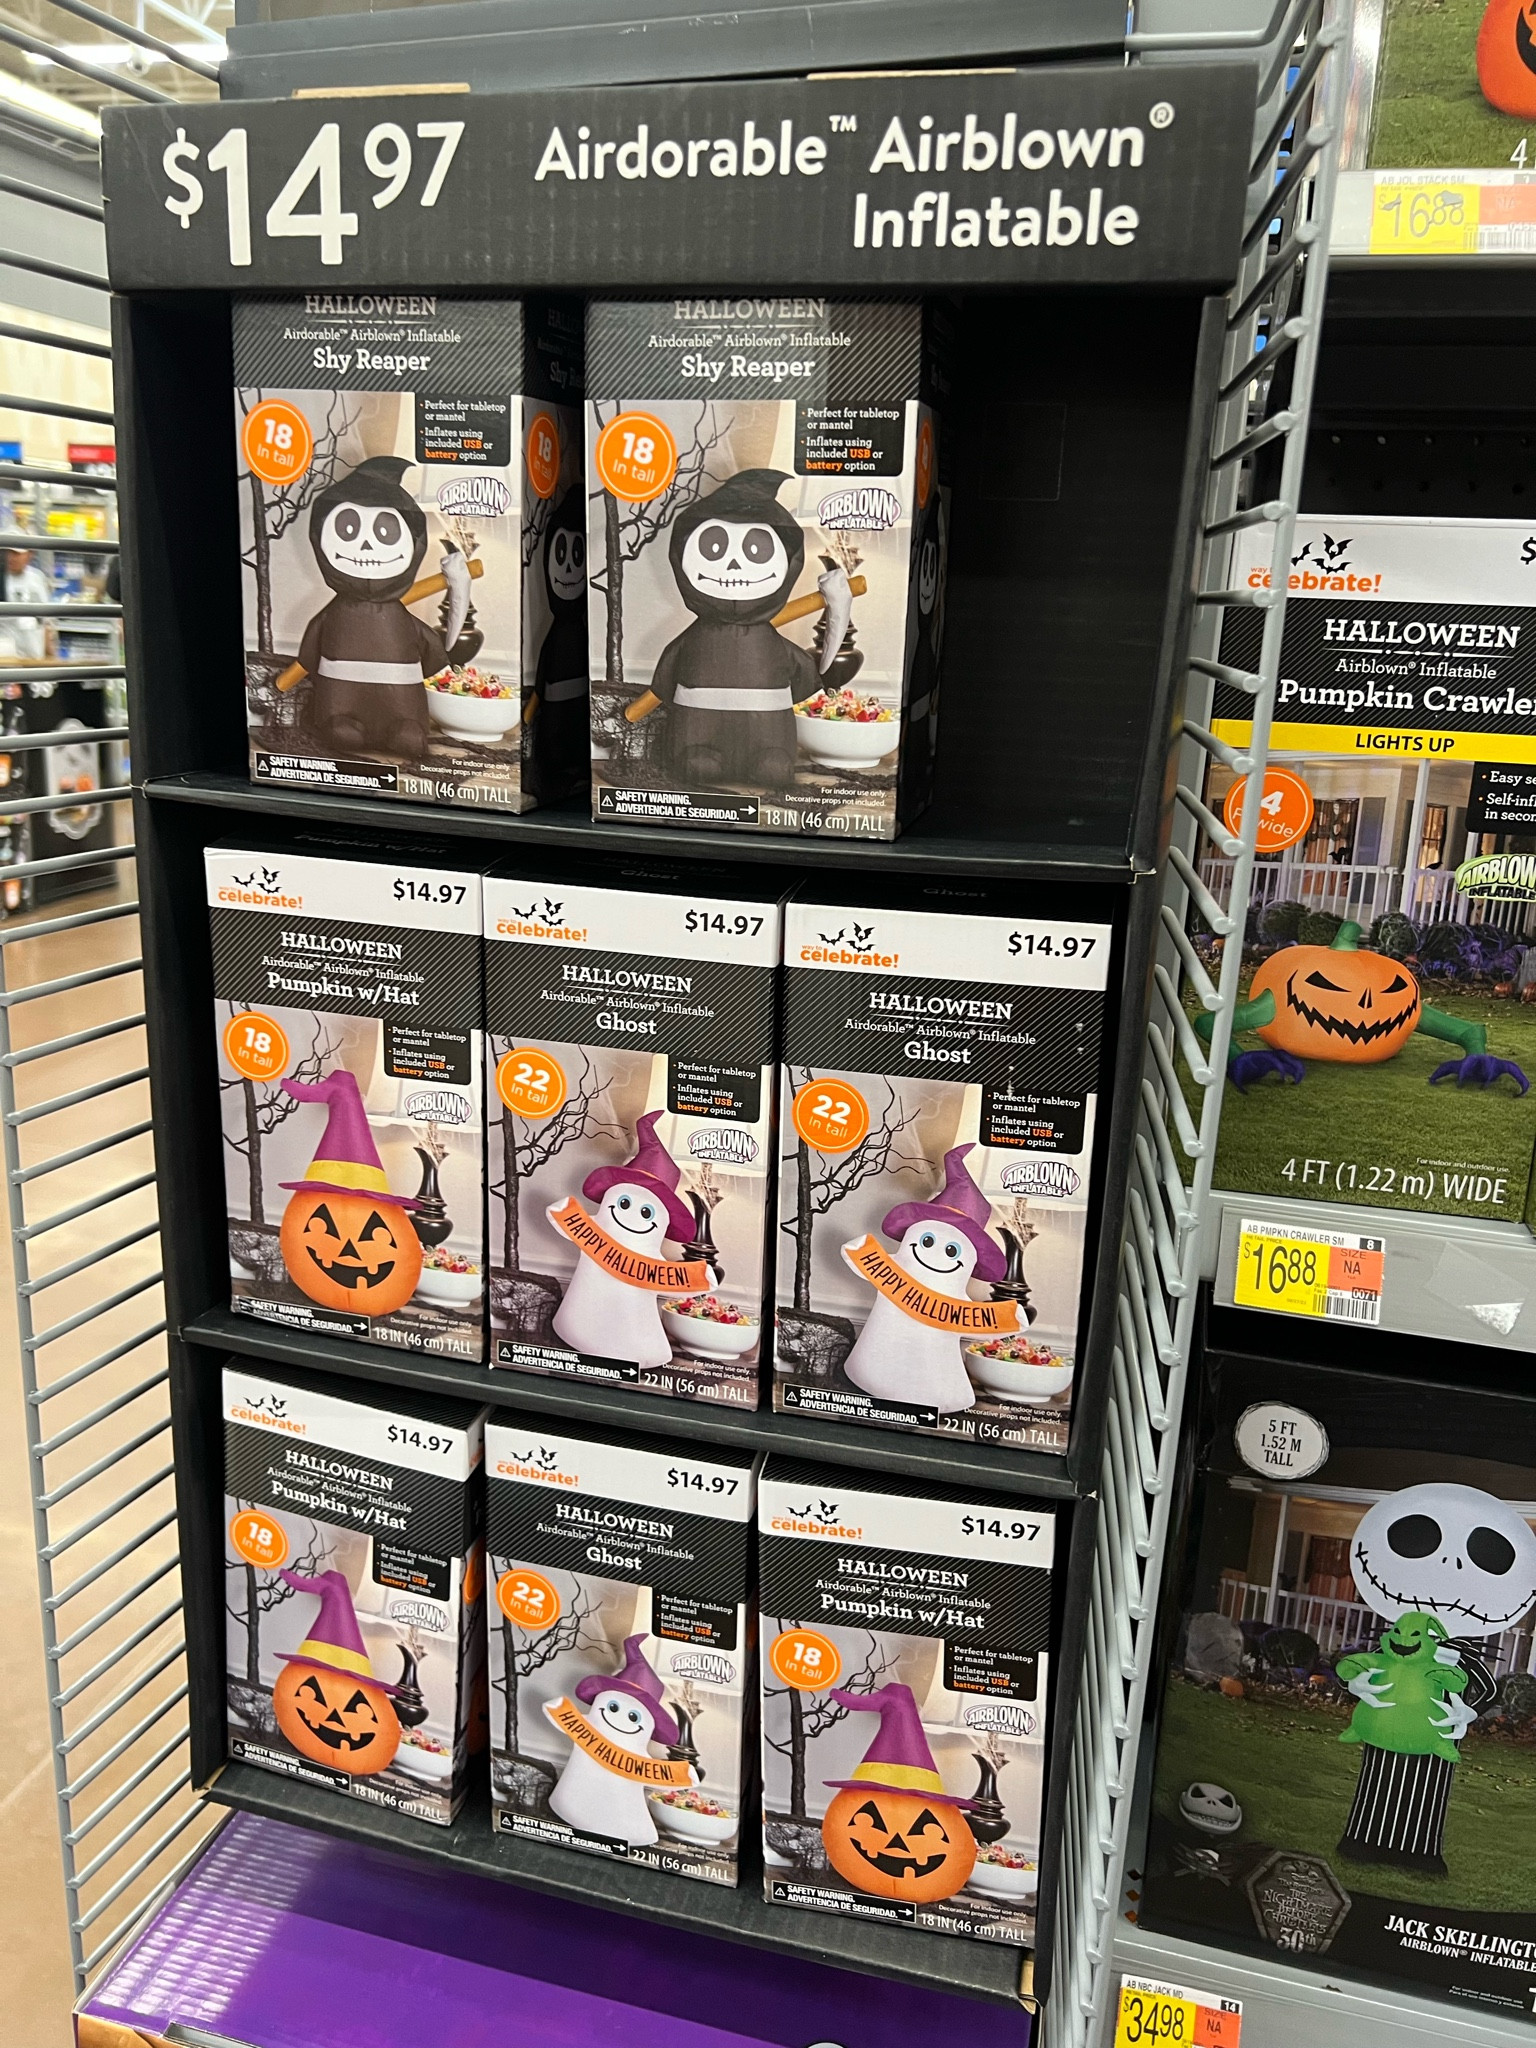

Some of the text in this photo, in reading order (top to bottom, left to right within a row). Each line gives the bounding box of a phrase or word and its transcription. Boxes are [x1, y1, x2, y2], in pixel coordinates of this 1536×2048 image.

[1418, 176, 1448, 184] STACK
[852, 191, 1140, 249] Inflatable
[305, 296, 437, 316] HALLOWEEN
[674, 298, 825, 319] HALLOWEEN
[790, 333, 851, 347] Inflatable
[313, 347, 431, 375] Shy Reaper
[681, 354, 815, 382] Shy Reaper
[807, 408, 900, 420] Perfect for tabletop
[807, 420, 853, 429] or mantel
[264, 419, 293, 448] 18
[806, 437, 872, 450] Inflates using
[621, 433, 655, 463] 18
[806, 448, 883, 459] included USB or
[631, 462, 656, 485] tall
[806, 460, 875, 472] battery option
[820, 489, 894, 525] AIRBLOWN
[829, 519, 883, 530] INFLATABLE
[1248, 571, 1381, 593] ceebrate!
[1323, 619, 1520, 648] HALLOWEEN
[1419, 663, 1497, 679] Inflatable
[1278, 679, 1536, 716] Pumpkin Crawle
[1356, 733, 1455, 752] LIGHTS UP
[1489, 771, 1523, 786] Easy
[1261, 791, 1283, 816] 4
[218, 889, 303, 909] celebrate!
[393, 878, 466, 905] $14.97
[1469, 886, 1536, 900] INFLATABLE
[496, 922, 587, 941] celebrate!
[685, 910, 764, 936] $14.97
[280, 932, 402, 959] HALLOWEEN
[1007, 931, 1096, 959] $14.97
[800, 948, 899, 968] celebrate!
[267, 972, 419, 1005] Pumpkin w/Hat
[562, 964, 692, 993] HALLOWEEN
[662, 1002, 714, 1018] Inflatable
[869, 992, 1013, 1019] HALLOWEEN
[596, 1012, 657, 1034] Ghost
[244, 1027, 272, 1053] 18
[977, 1030, 1036, 1045] Inflatable
[904, 1041, 971, 1064] Ghost
[513, 1063, 550, 1090] 22
[527, 1087, 548, 1105] tall
[812, 1095, 852, 1125] 22
[1429, 1158, 1451, 1166] indoor
[1467, 1163, 1495, 1171] outdoor
[1281, 1159, 1507, 1203] 4 FT (1.22 m) WIDE
[1247, 1225, 1258, 1233] AB
[1261, 1226, 1288, 1238] PMPKN
[1290, 1230, 1330, 1243] CRAWLER
[1333, 1236, 1344, 1245] SM
[1367, 1240, 1374, 1249] 8
[564, 1213, 691, 1287] HAPPY HALLOWEEN!
[1341, 1249, 1366, 1259] SIZE
[1343, 1261, 1361, 1275] NA
[860, 1251, 998, 1329] HAPPY HALLOWEEN!
[1353, 1289, 1375, 1300] 0071
[800, 1389, 873, 1408] SAFETY WARNING.
[231, 1407, 306, 1435] celebrate!
[800, 1400, 919, 1424] ADVERTENCIA DE SEGURIDAD.
[387, 1424, 453, 1454] $14.97
[943, 1418, 1060, 1446] 22 IN (56 cm) TALL
[1269, 1420, 1297, 1435] 5 FT
[1261, 1434, 1301, 1452] 1.52 M
[1264, 1450, 1293, 1466] TALL
[285, 1450, 393, 1490] HALLOWEEN
[497, 1463, 579, 1486] celebrate!
[667, 1468, 739, 1495] $14.97
[272, 1480, 407, 1530] Pumpkin w/Hat
[555, 1504, 674, 1538] HALLOWEEN
[771, 1519, 862, 1539] celebrate!
[961, 1516, 1040, 1540] $14.97
[248, 1522, 273, 1546] 18
[587, 1547, 642, 1570] Ghost
[838, 1558, 968, 1587] HALLOWEEN
[512, 1582, 546, 1607] 22
[820, 1594, 984, 1628] Pumpkin w/Hat
[792, 1642, 822, 1666] 18
[559, 1711, 674, 1782] HAPPY HALLOWEEN!
[921, 1914, 1026, 1942] 18 IN (46 cm) TALL
[1384, 1915, 1430, 1939] JACK
[1127, 1980, 1183, 1999] AB NBC JACK MD
[1204, 2008, 1226, 2020] SIZE
[1224, 2002, 1235, 2012] 14
[1207, 2018, 1221, 2034] NA
